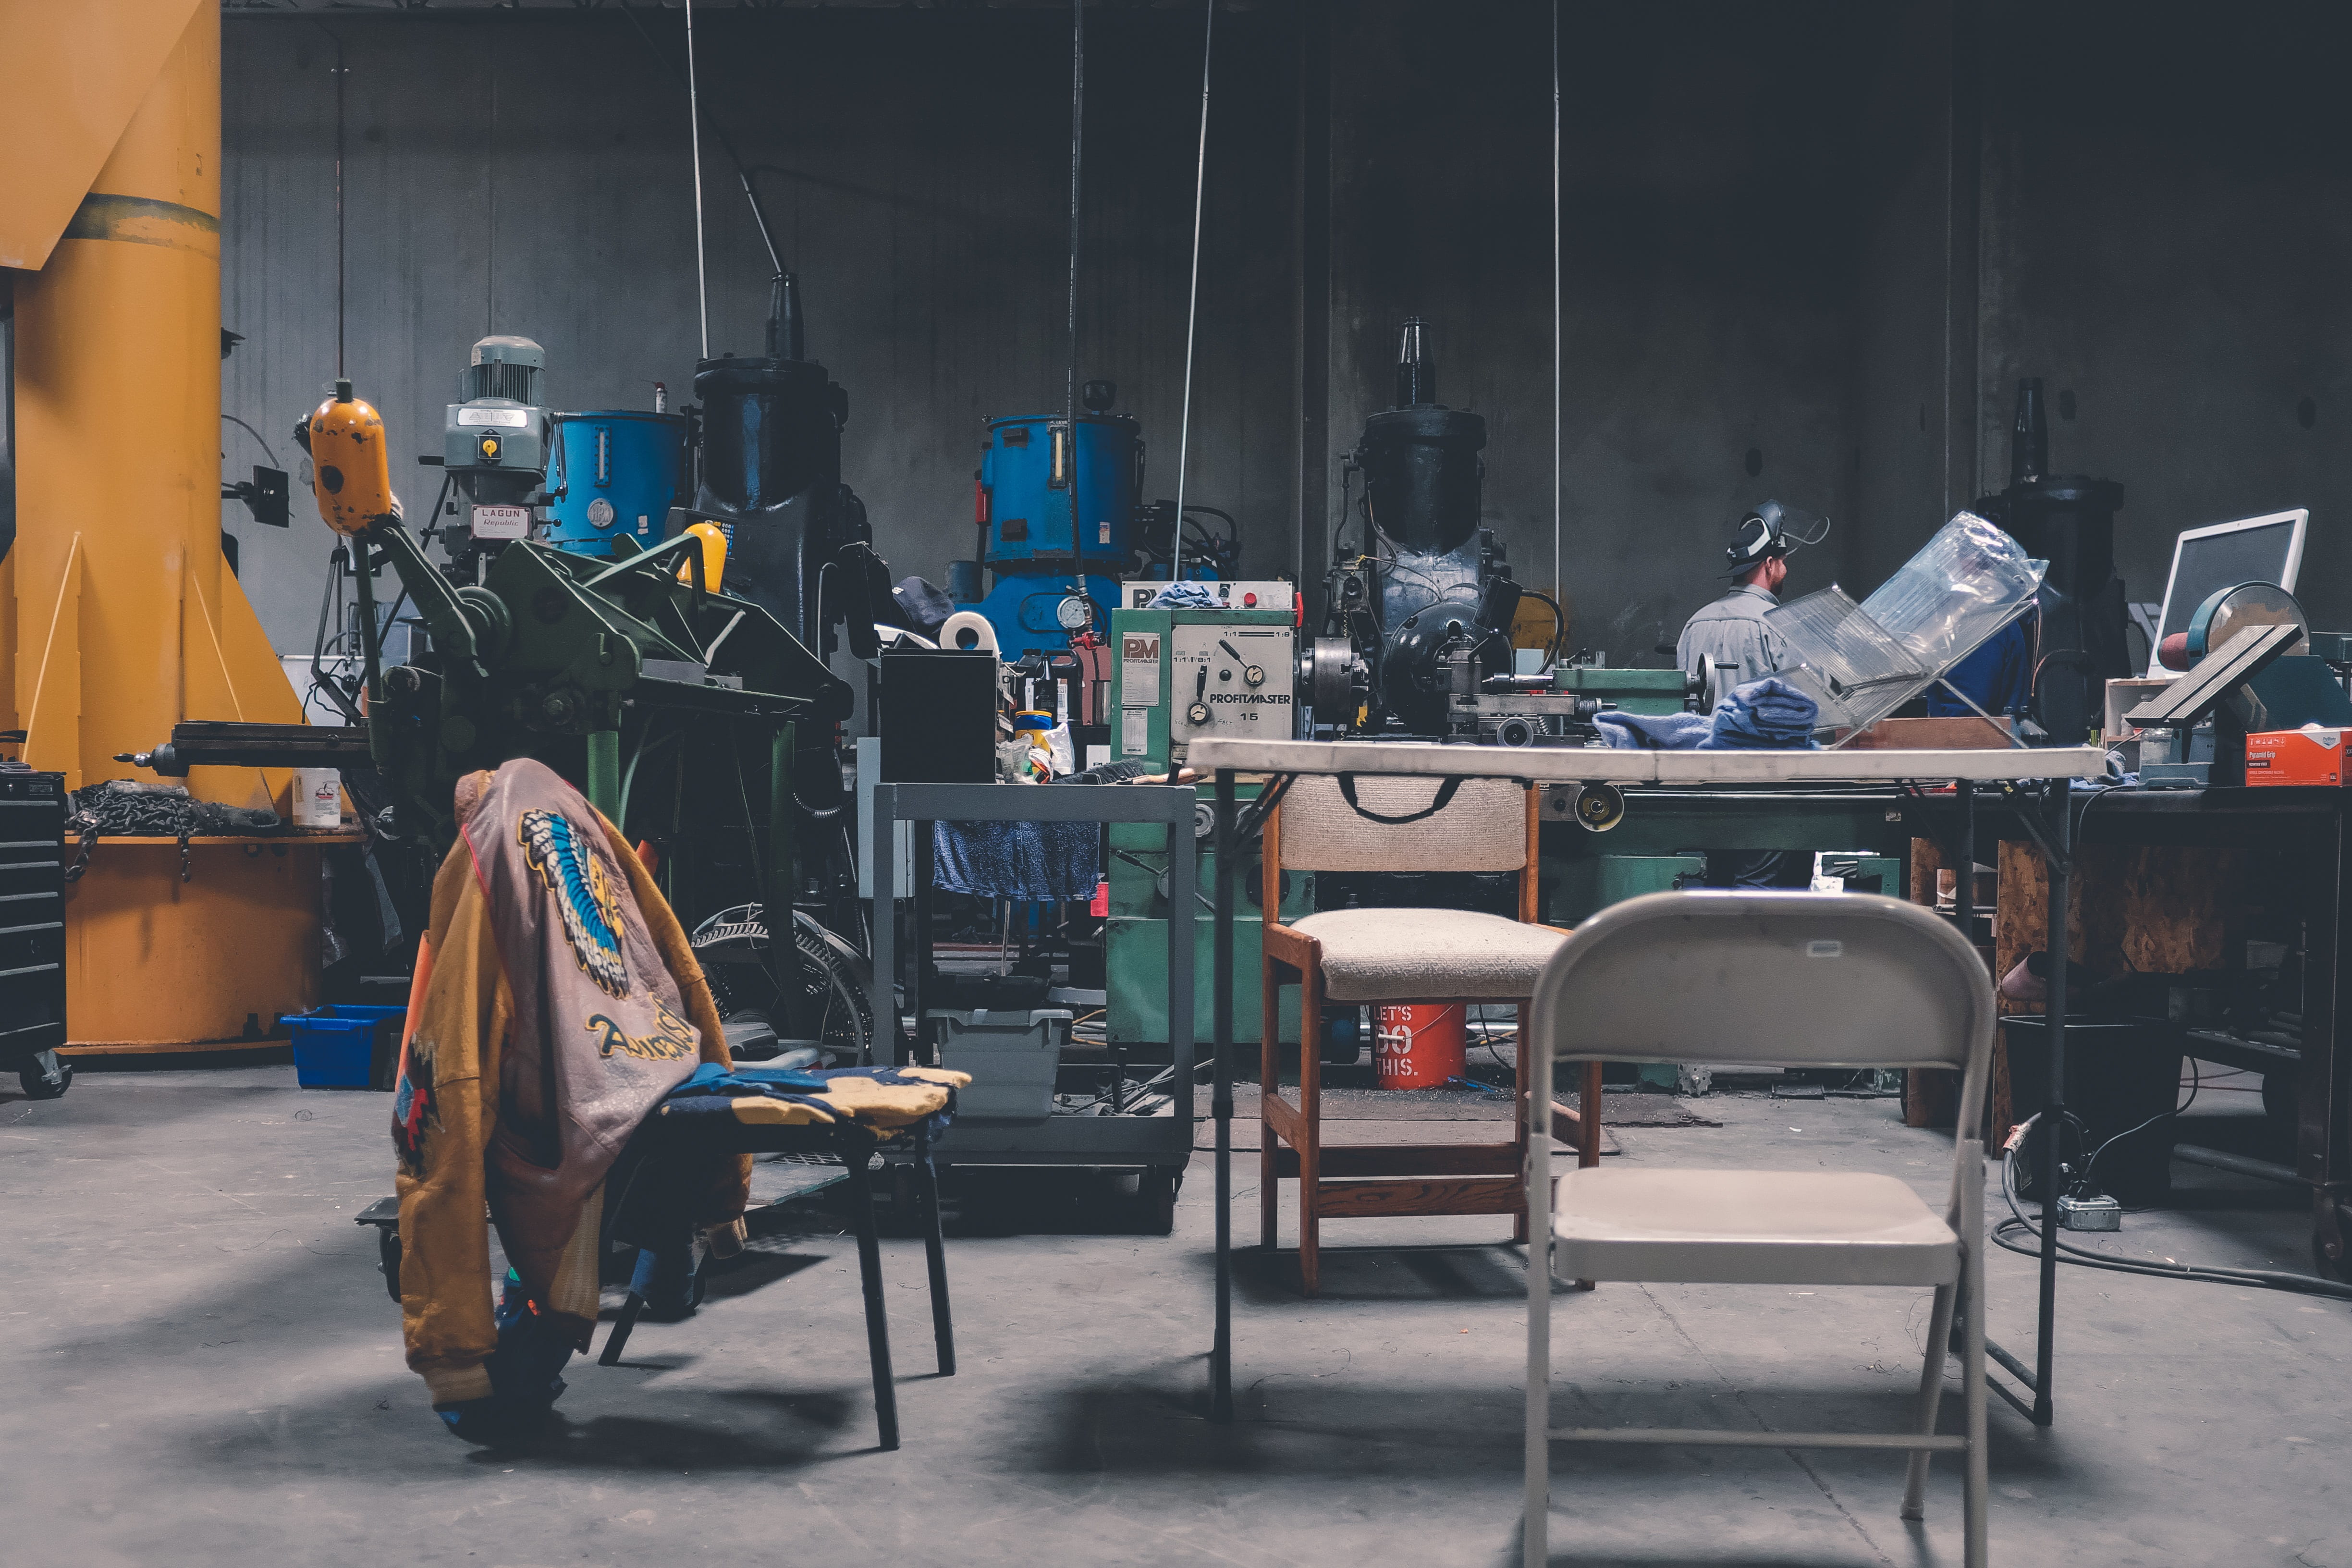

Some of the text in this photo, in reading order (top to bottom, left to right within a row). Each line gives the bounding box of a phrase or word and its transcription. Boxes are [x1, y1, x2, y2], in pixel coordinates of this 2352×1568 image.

[1133, 589, 1157, 609] P
[1124, 639, 1159, 659] PM
[1210, 694, 1291, 704] PROFITMASTER
[2249, 751, 2276, 760] Pyramid Grip
[1374, 1006, 1412, 1021] LET'S
[1375, 1024, 1412, 1054] DO
[1376, 1058, 1418, 1076] THIS.
